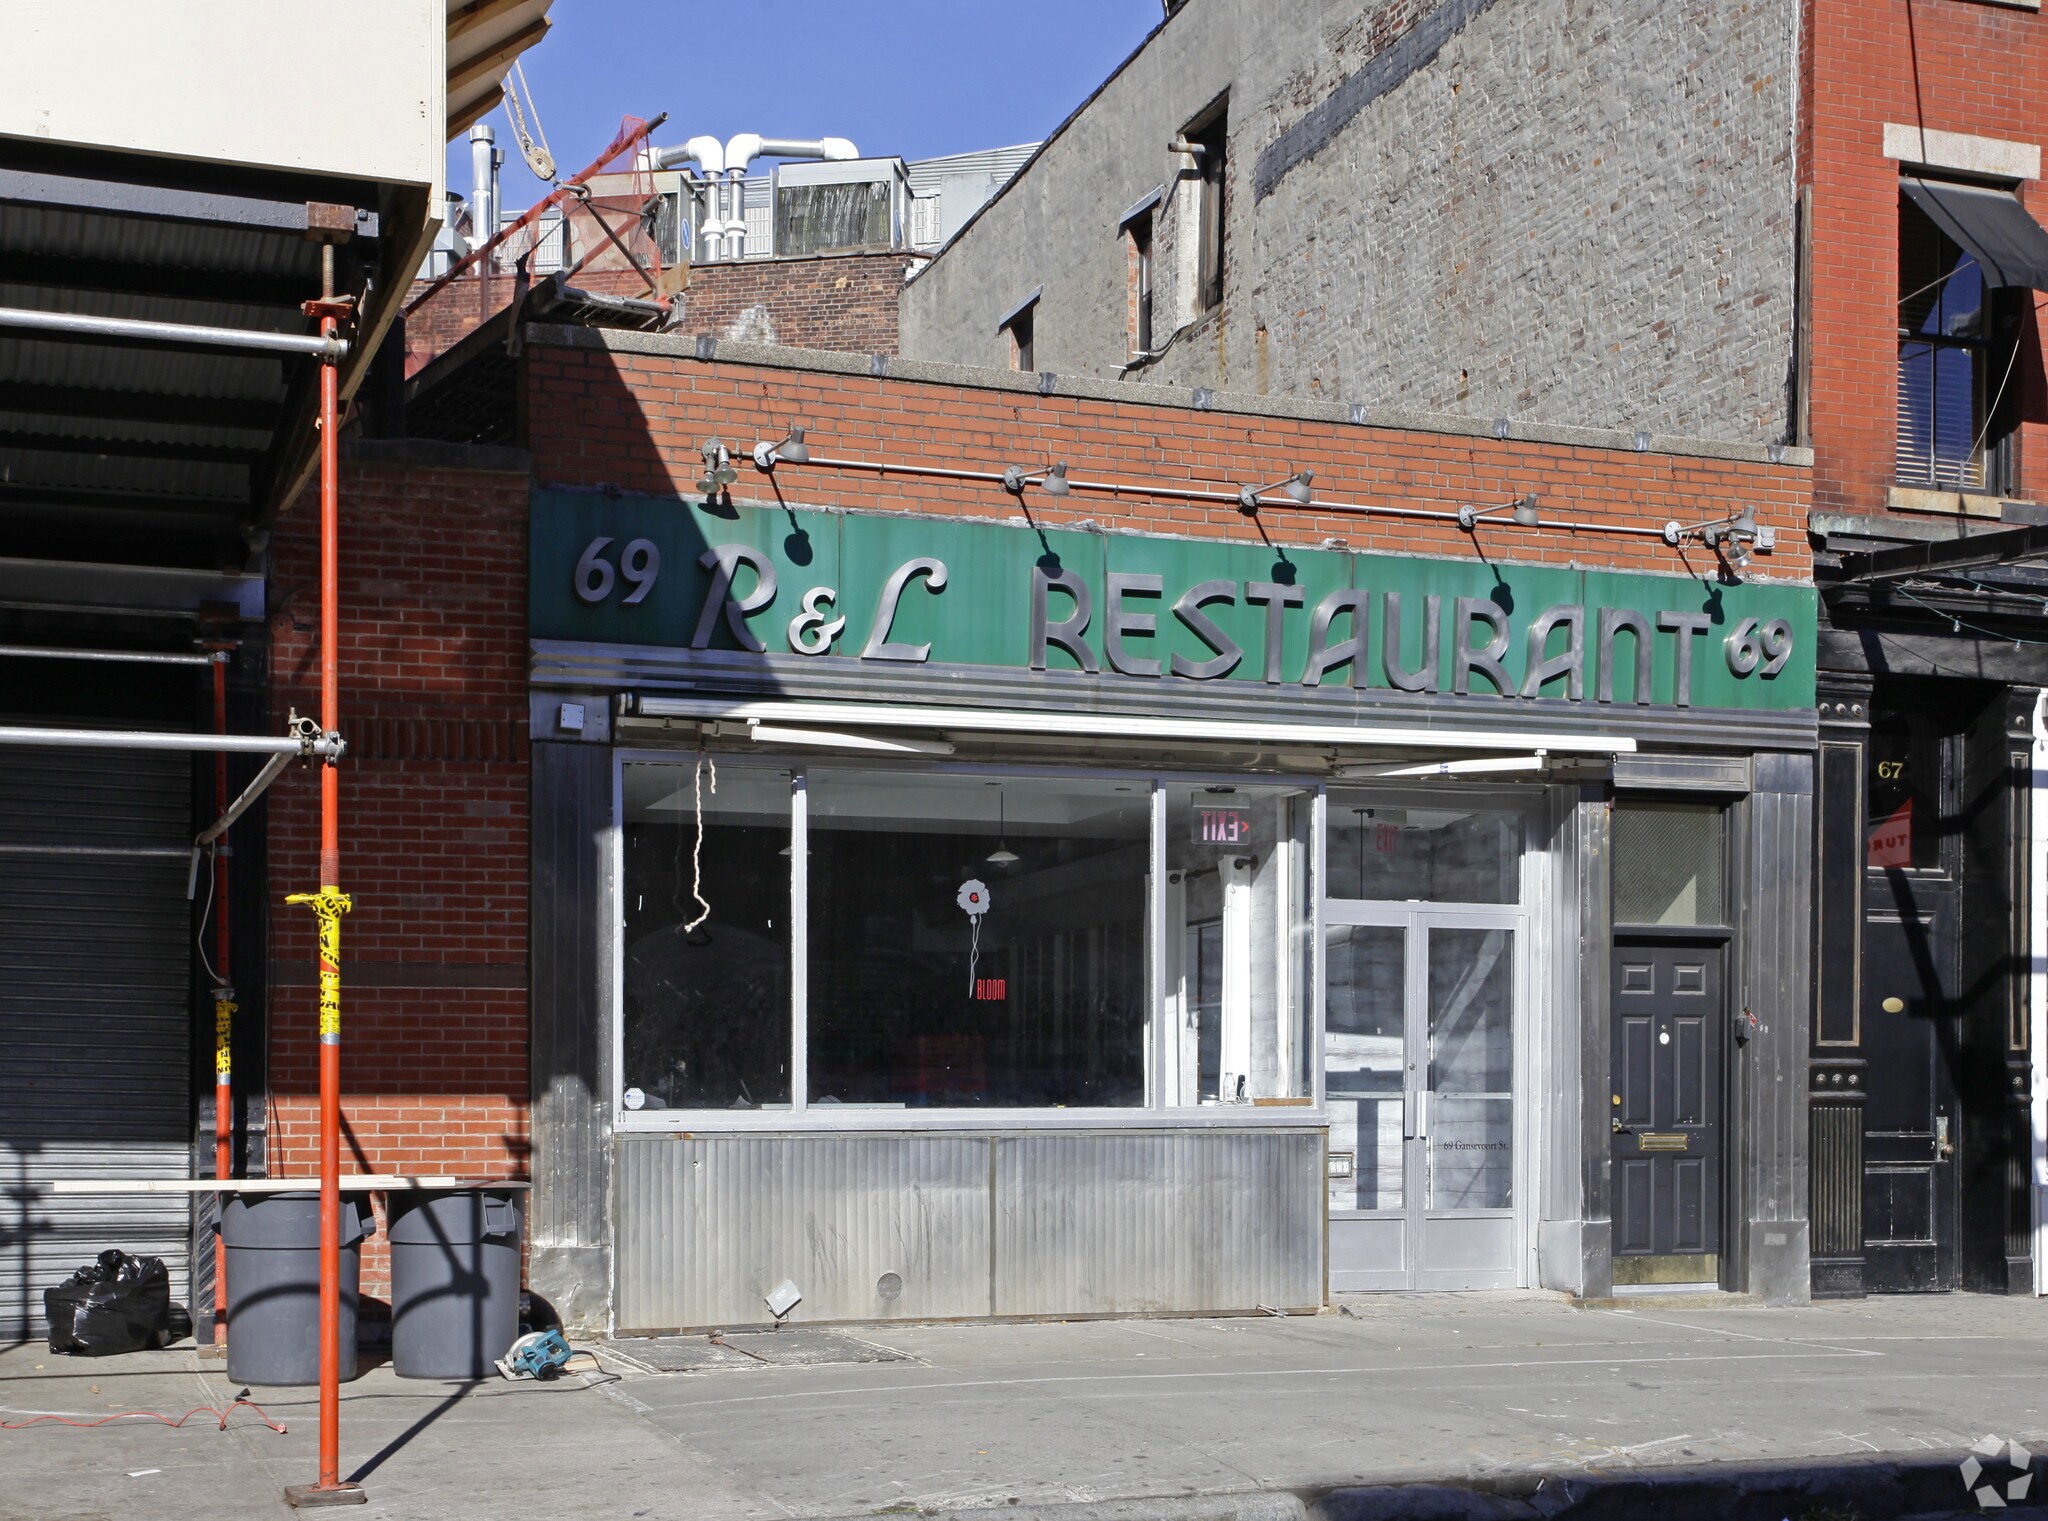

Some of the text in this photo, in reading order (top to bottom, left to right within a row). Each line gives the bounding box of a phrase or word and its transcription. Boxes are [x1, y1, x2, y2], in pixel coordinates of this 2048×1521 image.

[574, 536, 661, 604] 69
[1029, 565, 1713, 708] RESTAURANT
[1723, 615, 1794, 680] 69
[1878, 761, 1904, 779] 67
[977, 979, 1006, 1000] BLOOM
[1443, 1141, 1454, 1151] 69
[1455, 1140, 1497, 1151] Gansevoort
